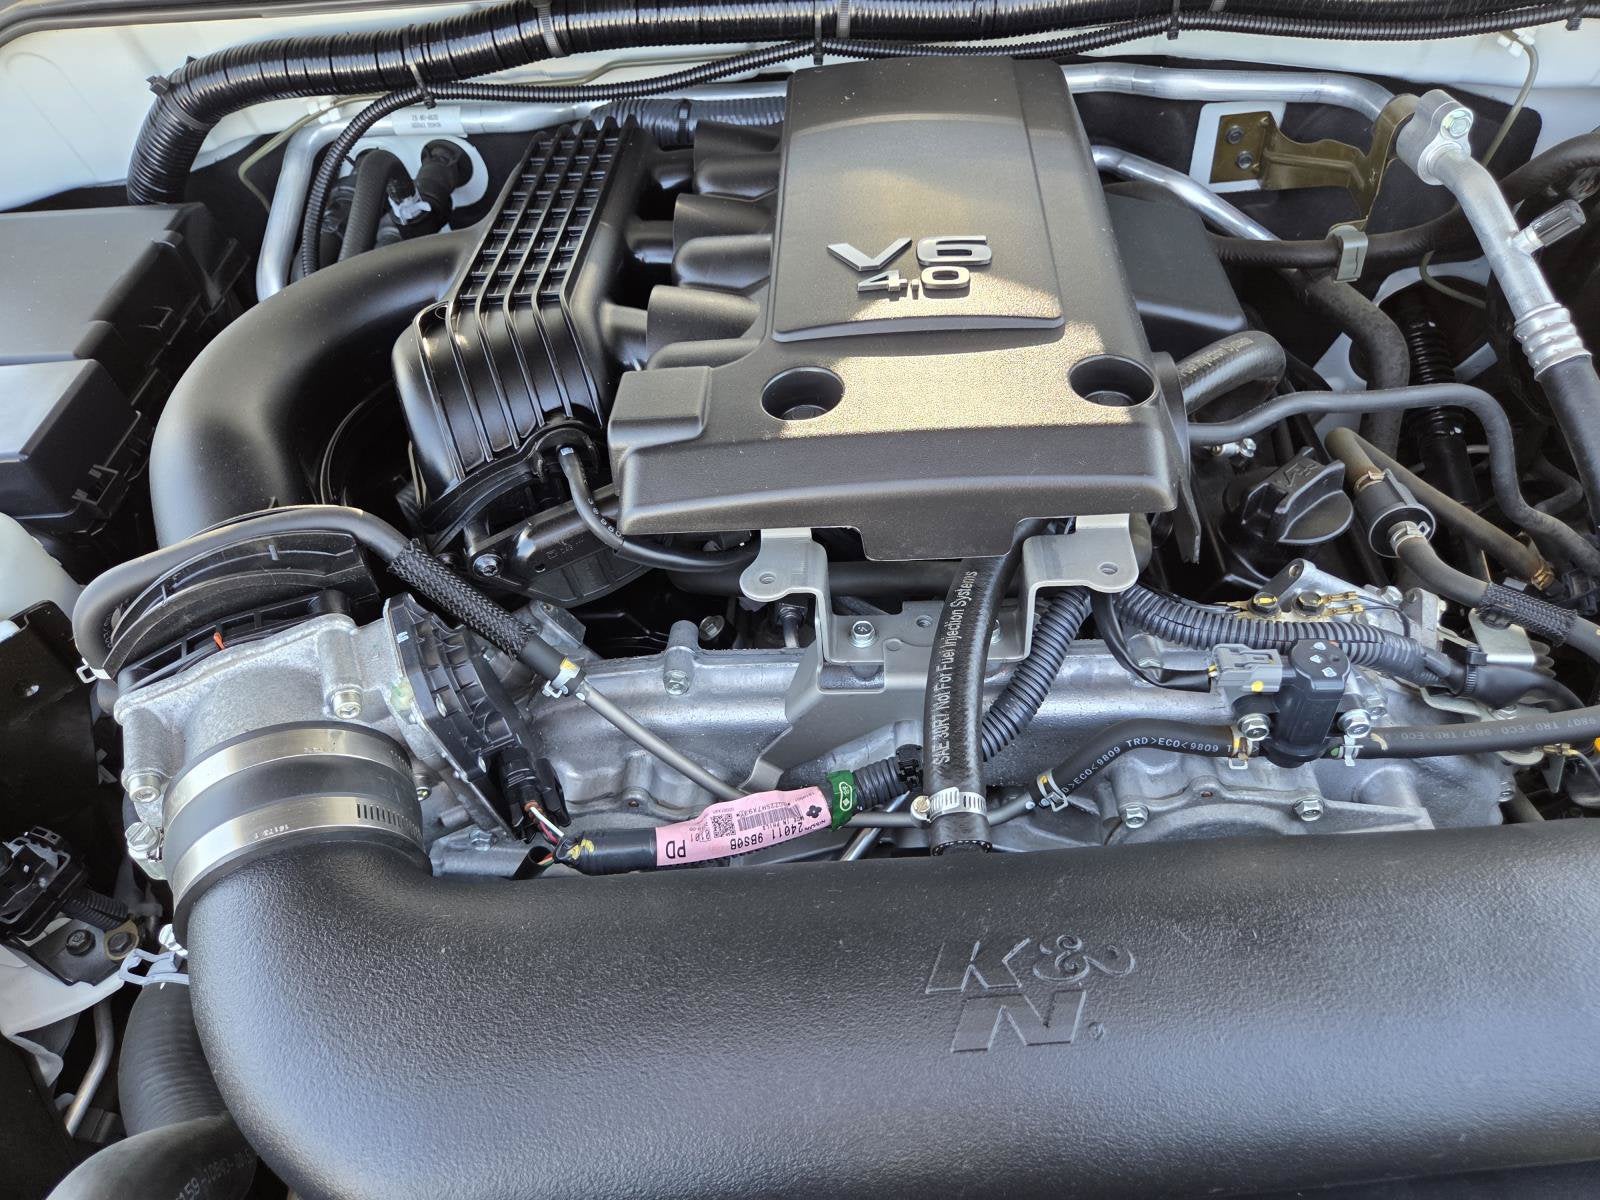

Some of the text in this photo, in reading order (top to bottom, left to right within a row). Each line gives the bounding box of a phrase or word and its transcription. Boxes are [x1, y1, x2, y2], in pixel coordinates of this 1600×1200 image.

[827, 235, 992, 271] V6
[858, 266, 970, 293] 4.0
[950, 571, 978, 607] Systems
[940, 609, 964, 647] Injection
[936, 648, 955, 672] Fuel
[933, 673, 952, 691] For
[931, 691, 950, 711] Not
[932, 741, 950, 765] SAE
[771, 822, 804, 841] 24011
[665, 839, 686, 859] PD
